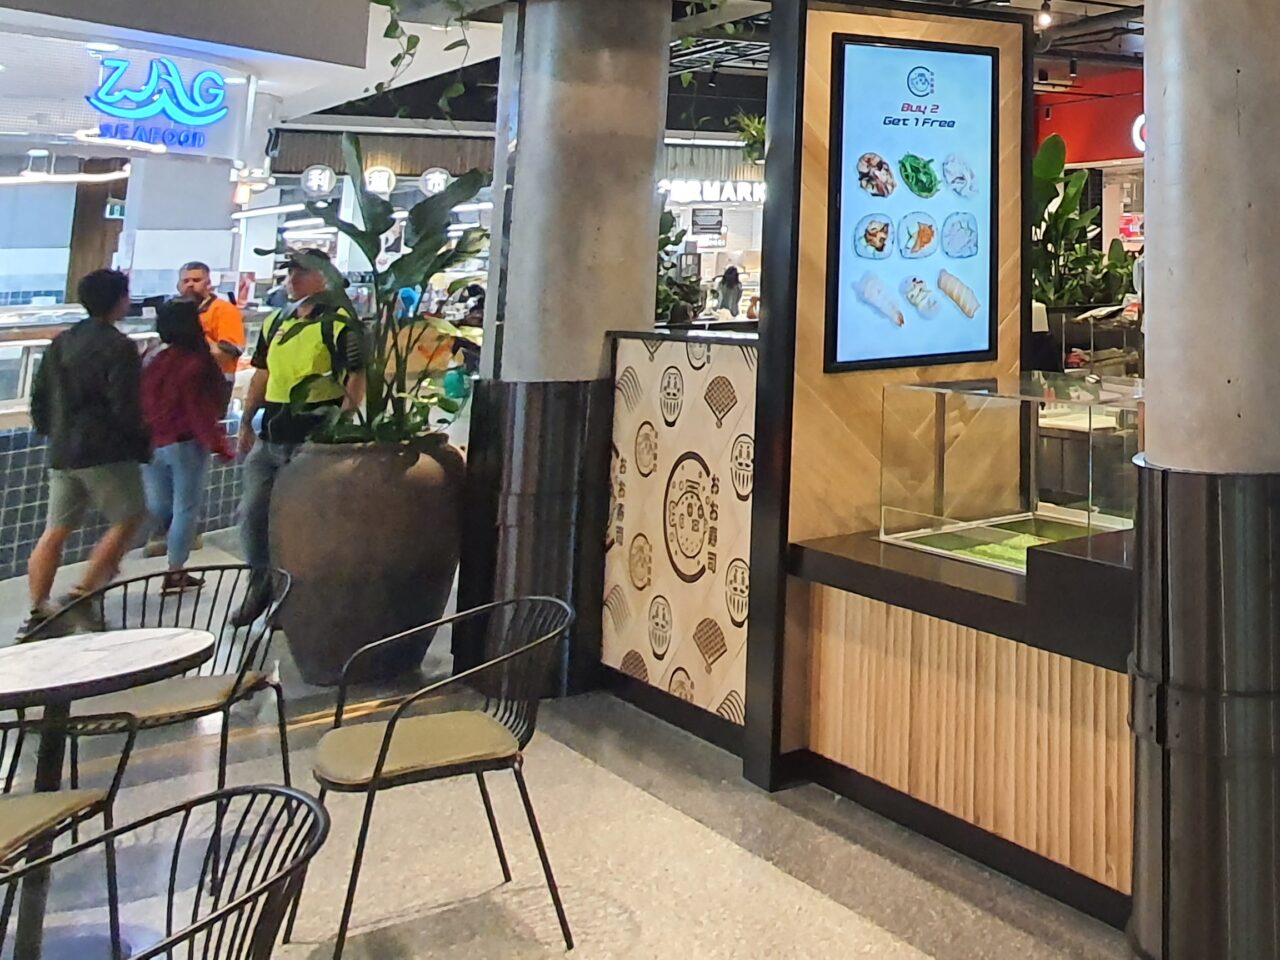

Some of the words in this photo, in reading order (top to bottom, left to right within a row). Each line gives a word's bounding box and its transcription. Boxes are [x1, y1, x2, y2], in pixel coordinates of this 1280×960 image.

[900, 102, 927, 115] Buy
[930, 104, 939, 113] 2
[883, 116, 910, 126] Get
[914, 117, 919, 127] 1
[921, 118, 956, 128] Free
